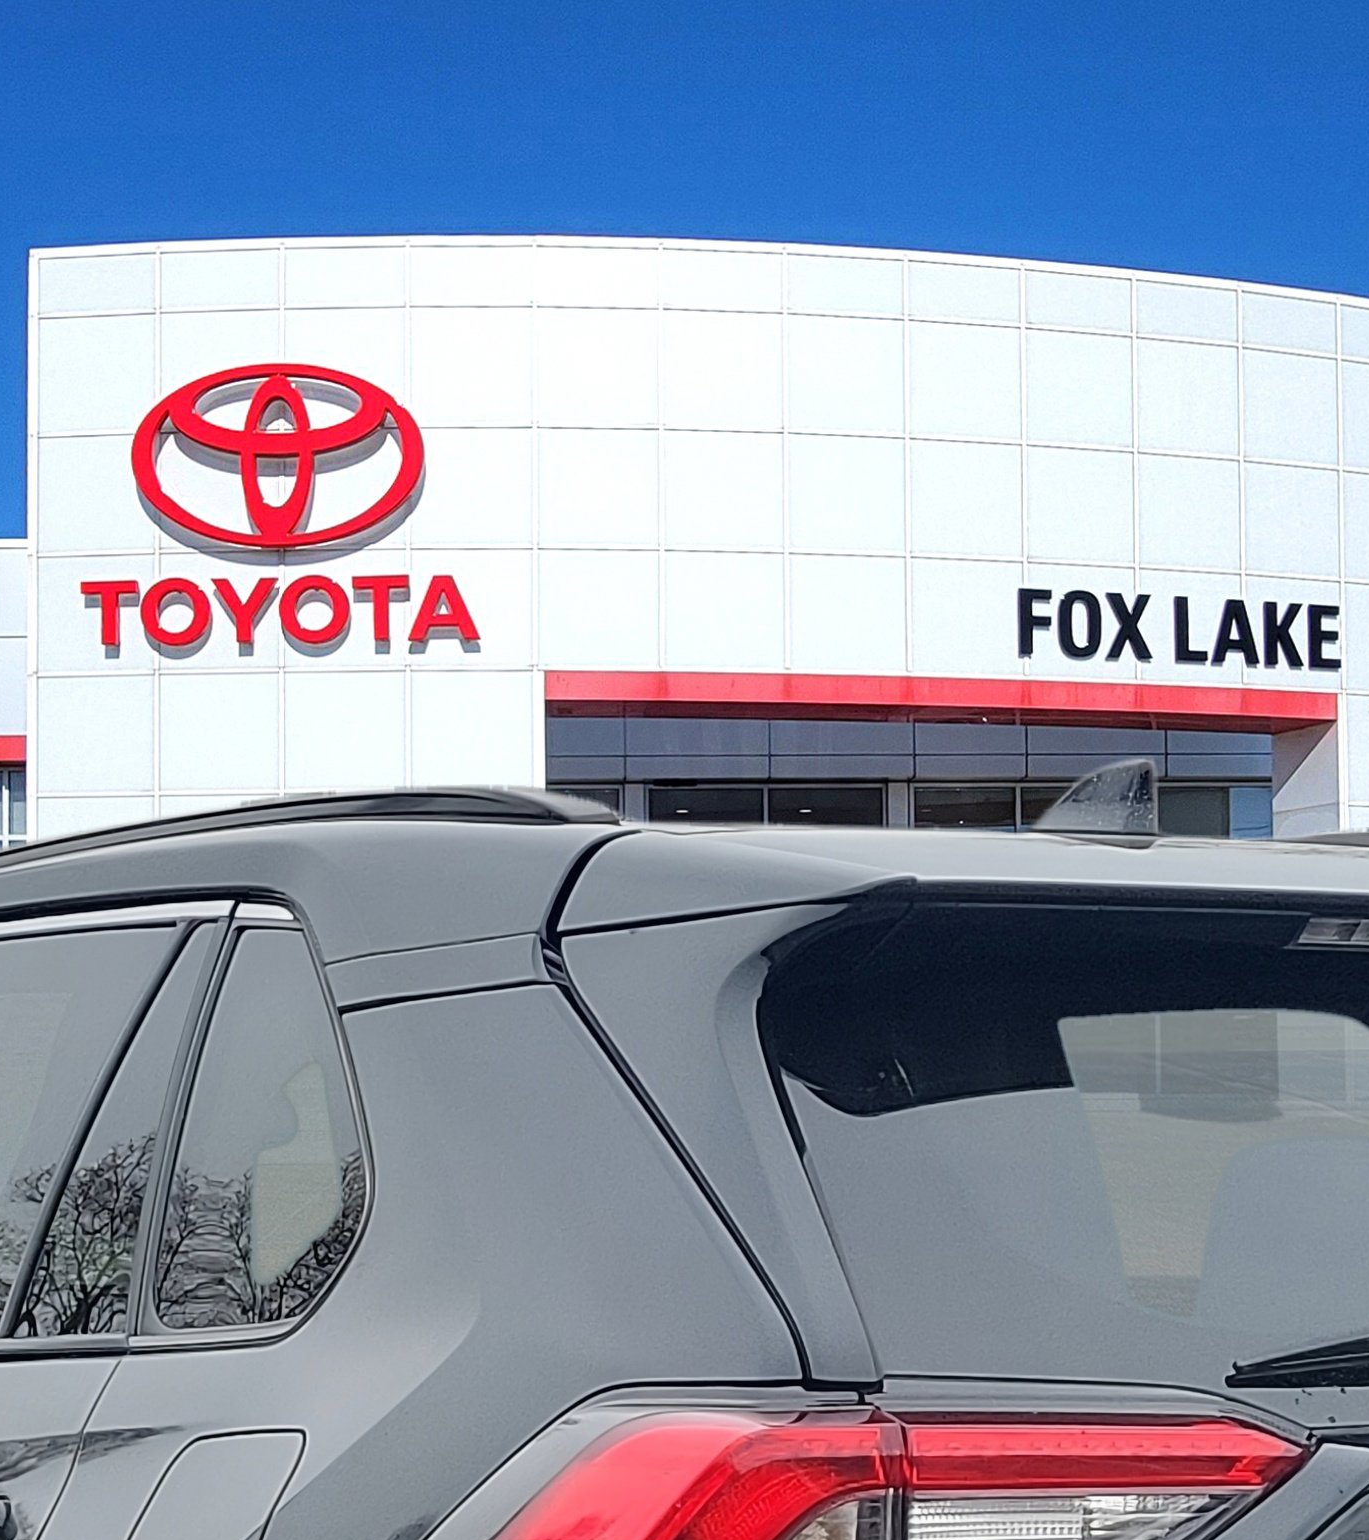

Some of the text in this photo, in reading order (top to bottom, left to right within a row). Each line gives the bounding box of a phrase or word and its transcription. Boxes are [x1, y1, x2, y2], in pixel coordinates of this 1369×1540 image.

[79, 574, 480, 648] TOYOTA
[1017, 587, 1343, 671] FOX LAKE
